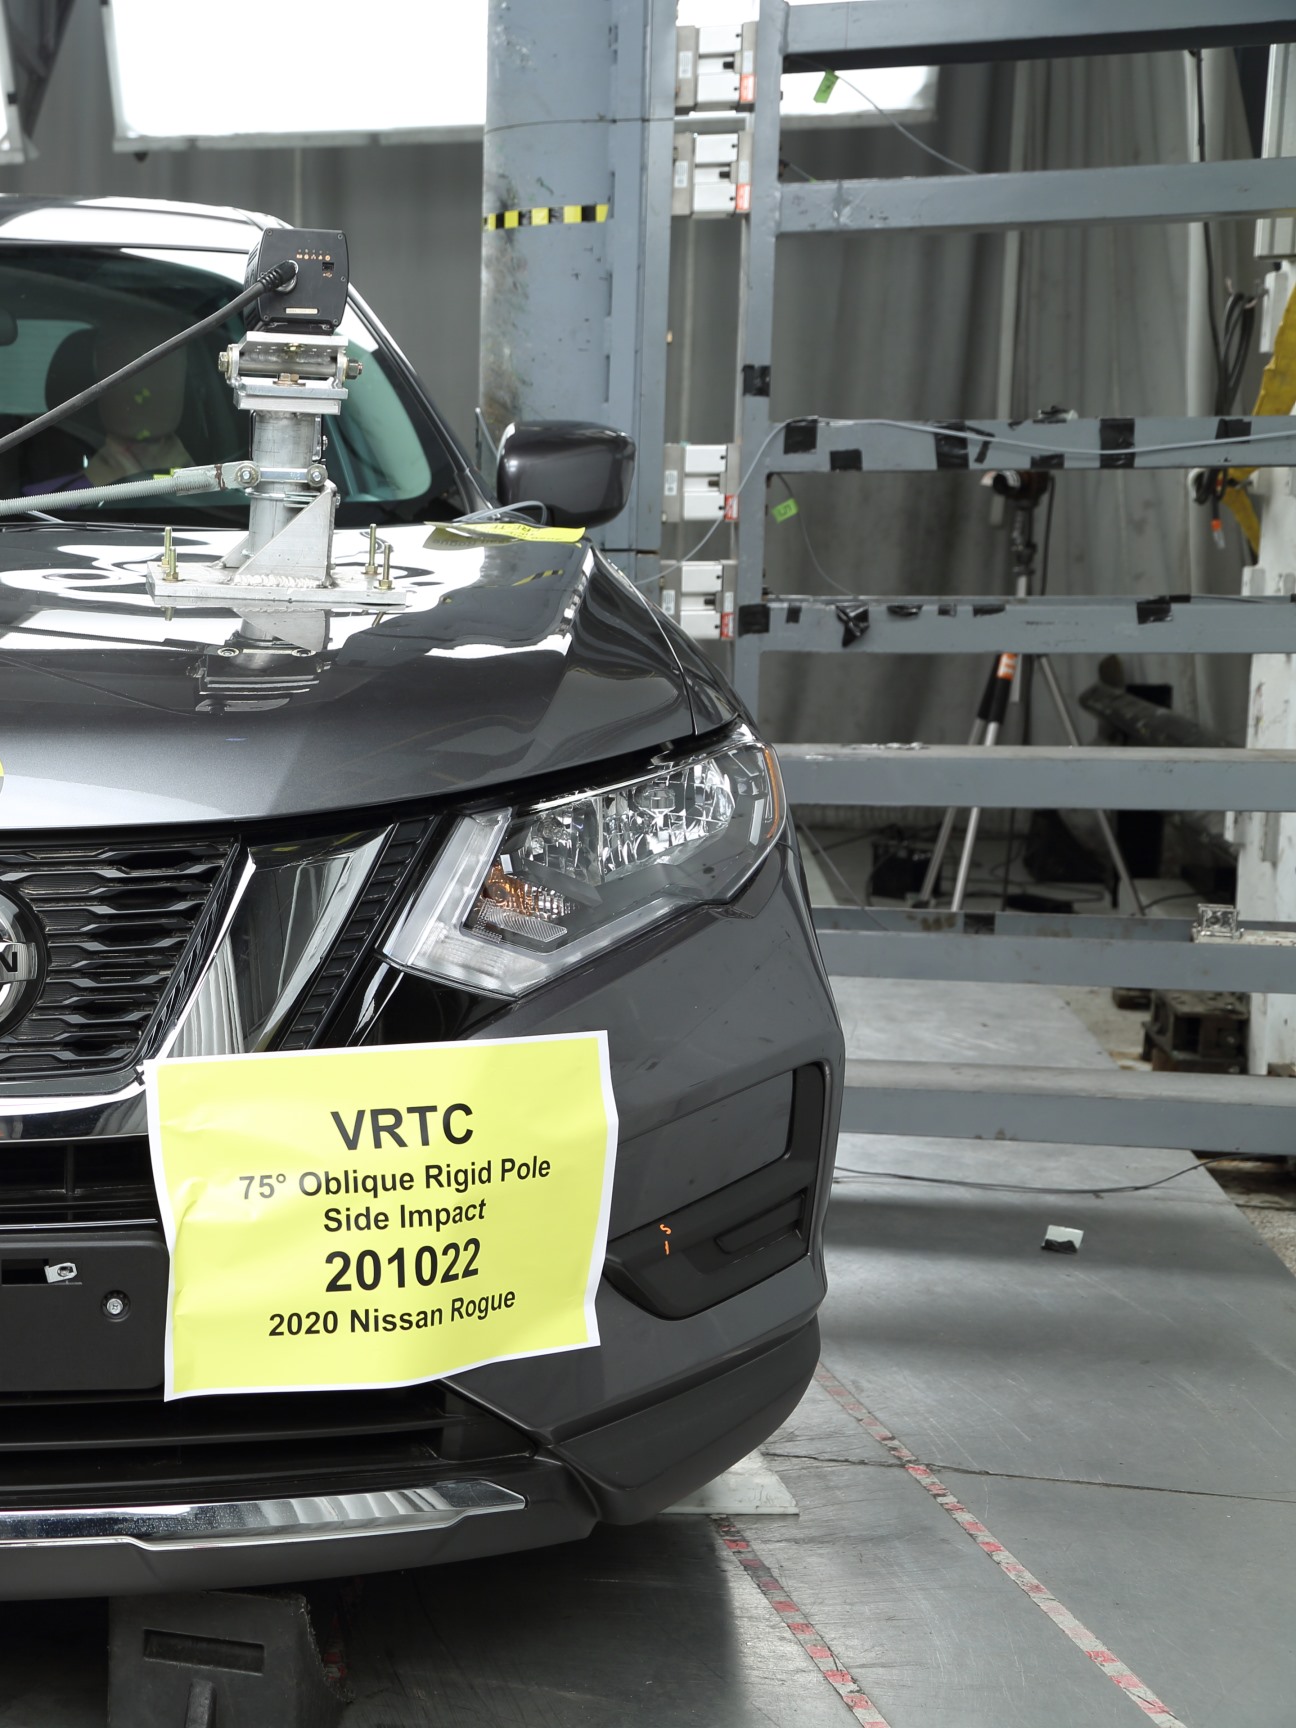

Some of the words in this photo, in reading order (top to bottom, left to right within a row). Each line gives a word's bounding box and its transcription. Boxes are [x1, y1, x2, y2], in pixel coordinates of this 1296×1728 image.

[330, 1103, 474, 1150] VRTC
[238, 1173, 287, 1200] 75°
[299, 1169, 415, 1199] Oblique
[425, 1160, 492, 1193] Rigid
[500, 1155, 552, 1182] Pole
[323, 1205, 390, 1232] Side
[400, 1198, 486, 1232] Impact
[325, 1238, 481, 1292] 201022
[268, 1310, 339, 1336] 2020
[351, 1308, 444, 1333] Nissan
[451, 1291, 516, 1321] Rogue
